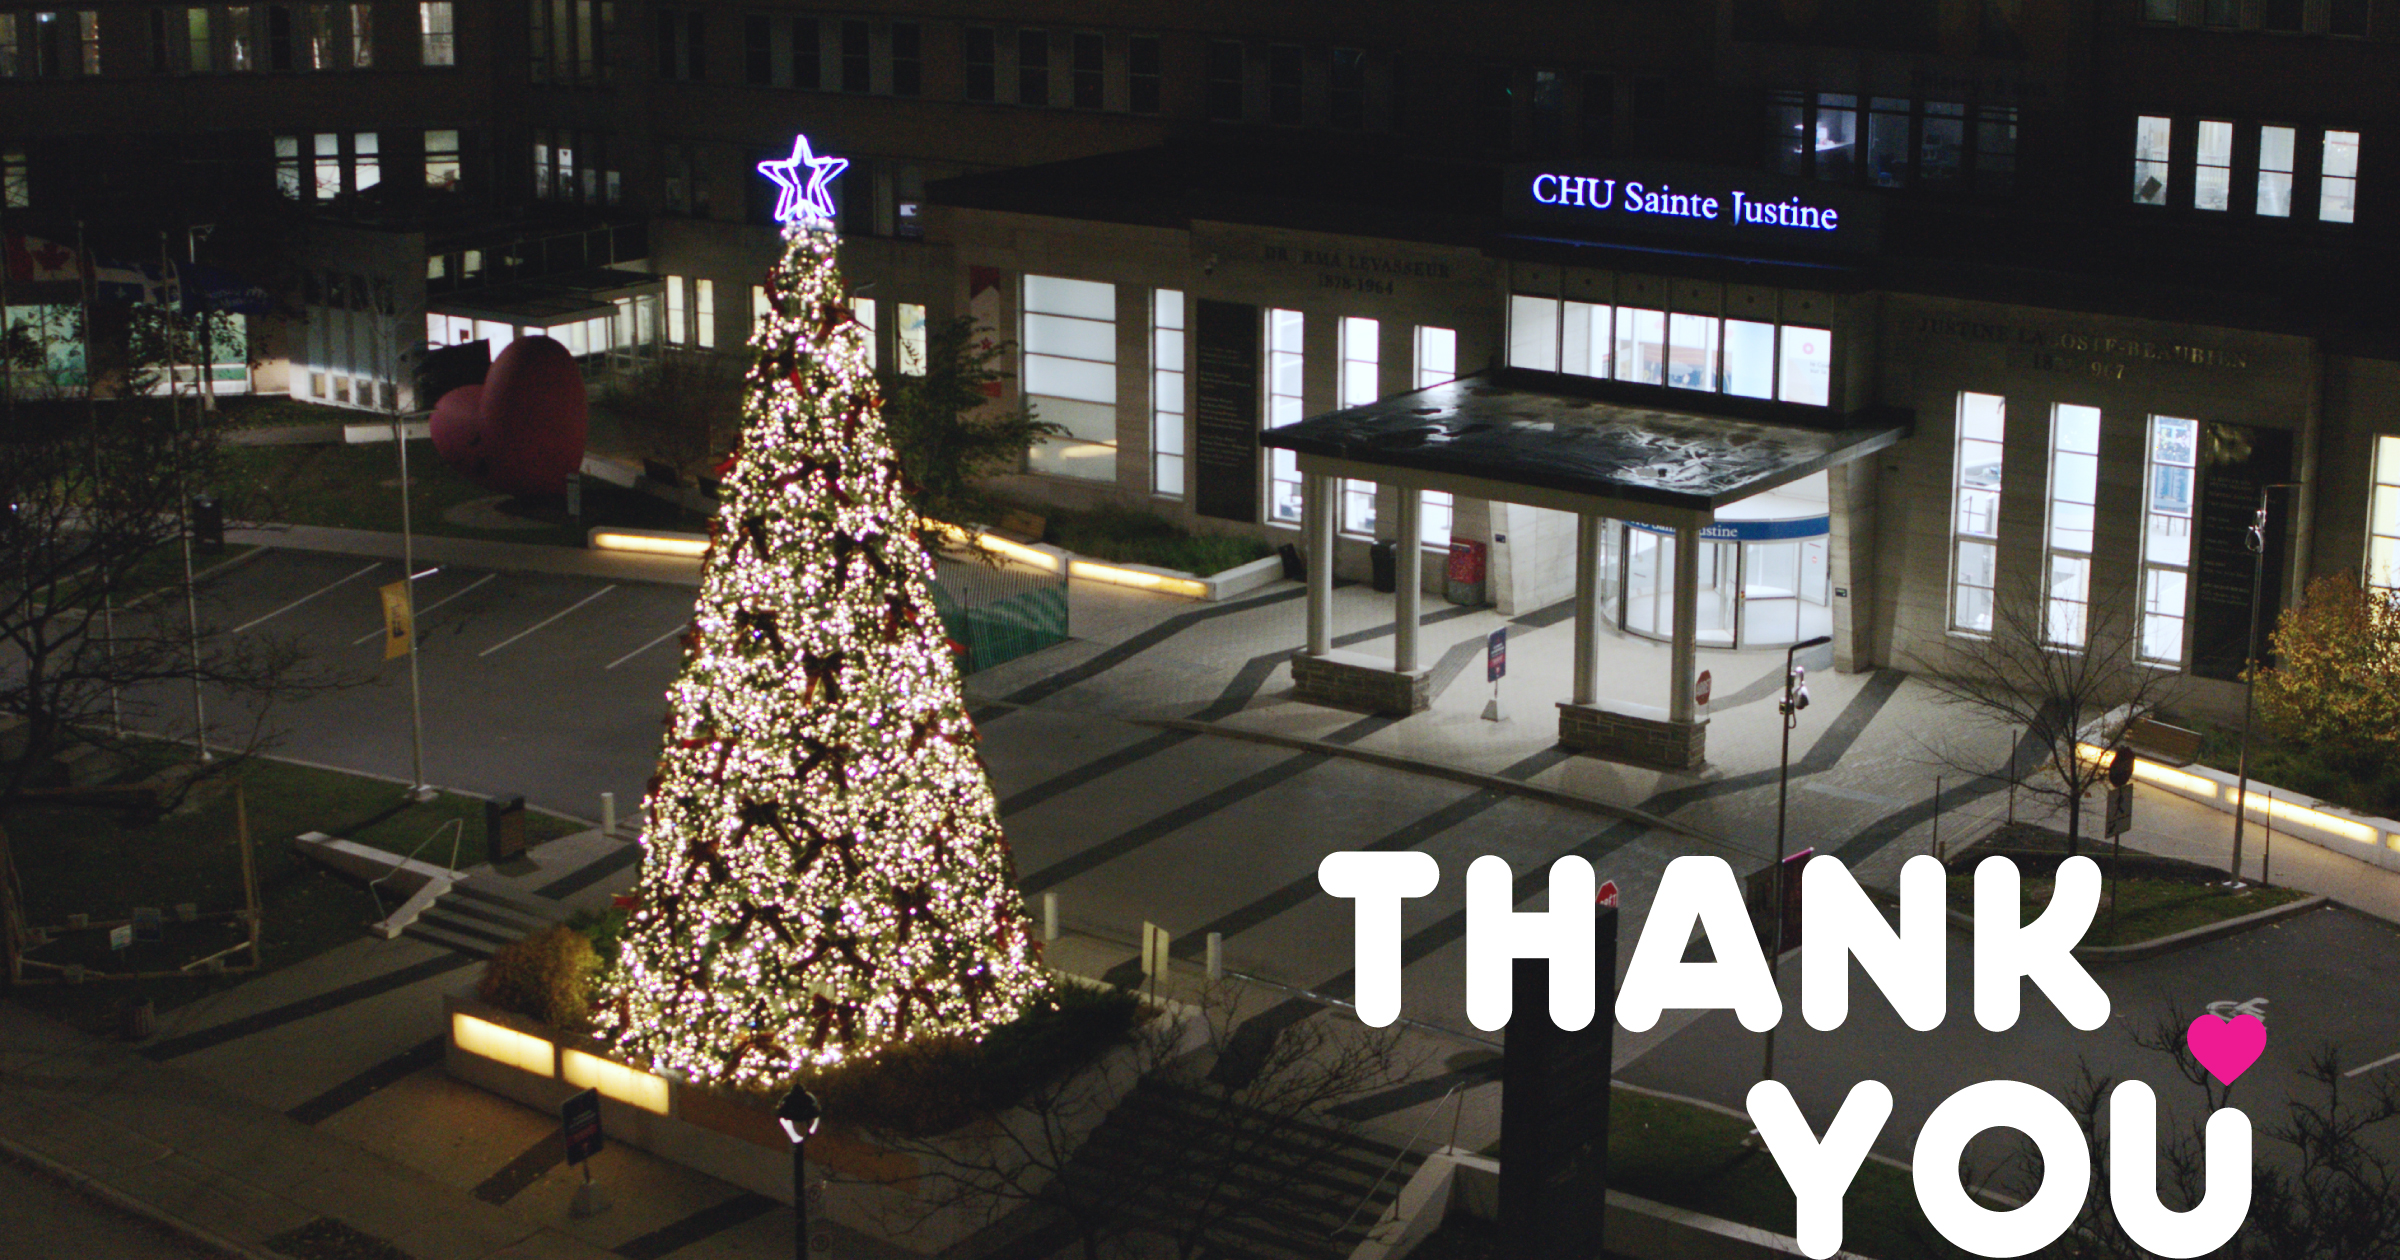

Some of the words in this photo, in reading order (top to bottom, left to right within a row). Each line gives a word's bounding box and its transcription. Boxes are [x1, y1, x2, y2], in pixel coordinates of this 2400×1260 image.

[1532, 173, 1617, 210] CHU
[1625, 182, 1719, 220] Sainte
[1730, 190, 1839, 232] Justine
[1698, 524, 1738, 538] ustine
